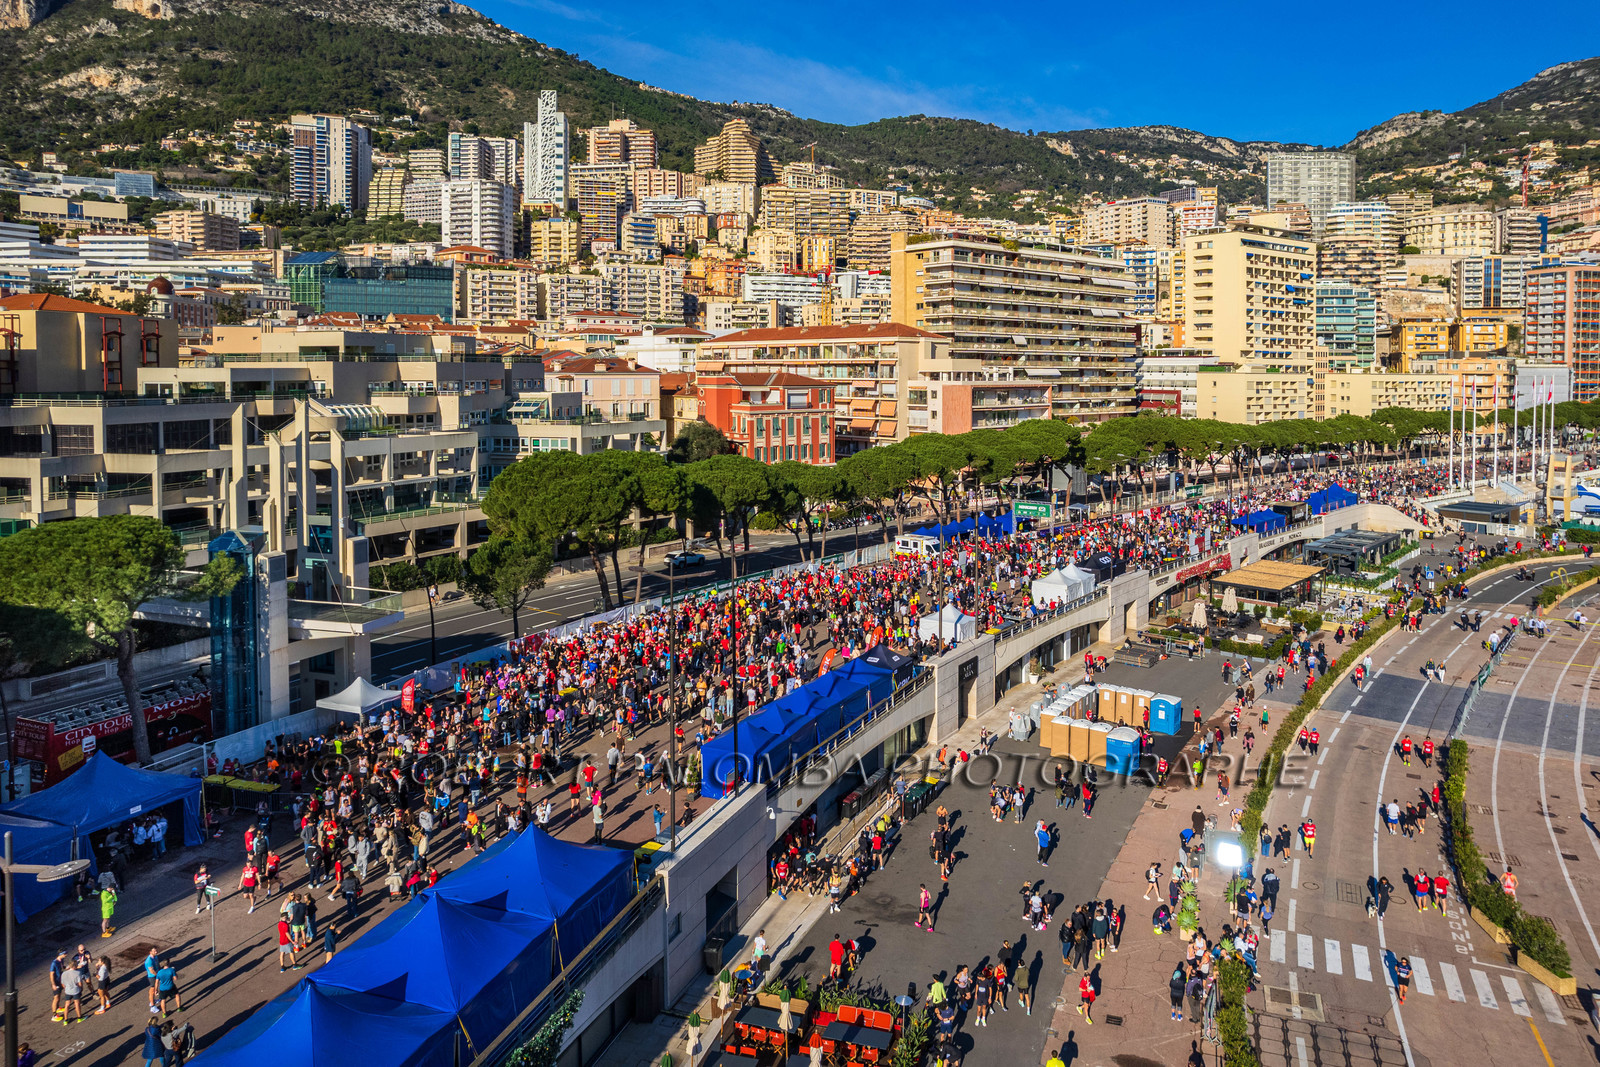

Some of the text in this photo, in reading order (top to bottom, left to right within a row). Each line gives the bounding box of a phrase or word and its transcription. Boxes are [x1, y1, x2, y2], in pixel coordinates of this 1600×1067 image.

[17, 721, 48, 731] MONACO
[65, 726, 95, 741] CITY
[97, 714, 133, 731] TOUR
[104, 726, 119, 735] Hop
